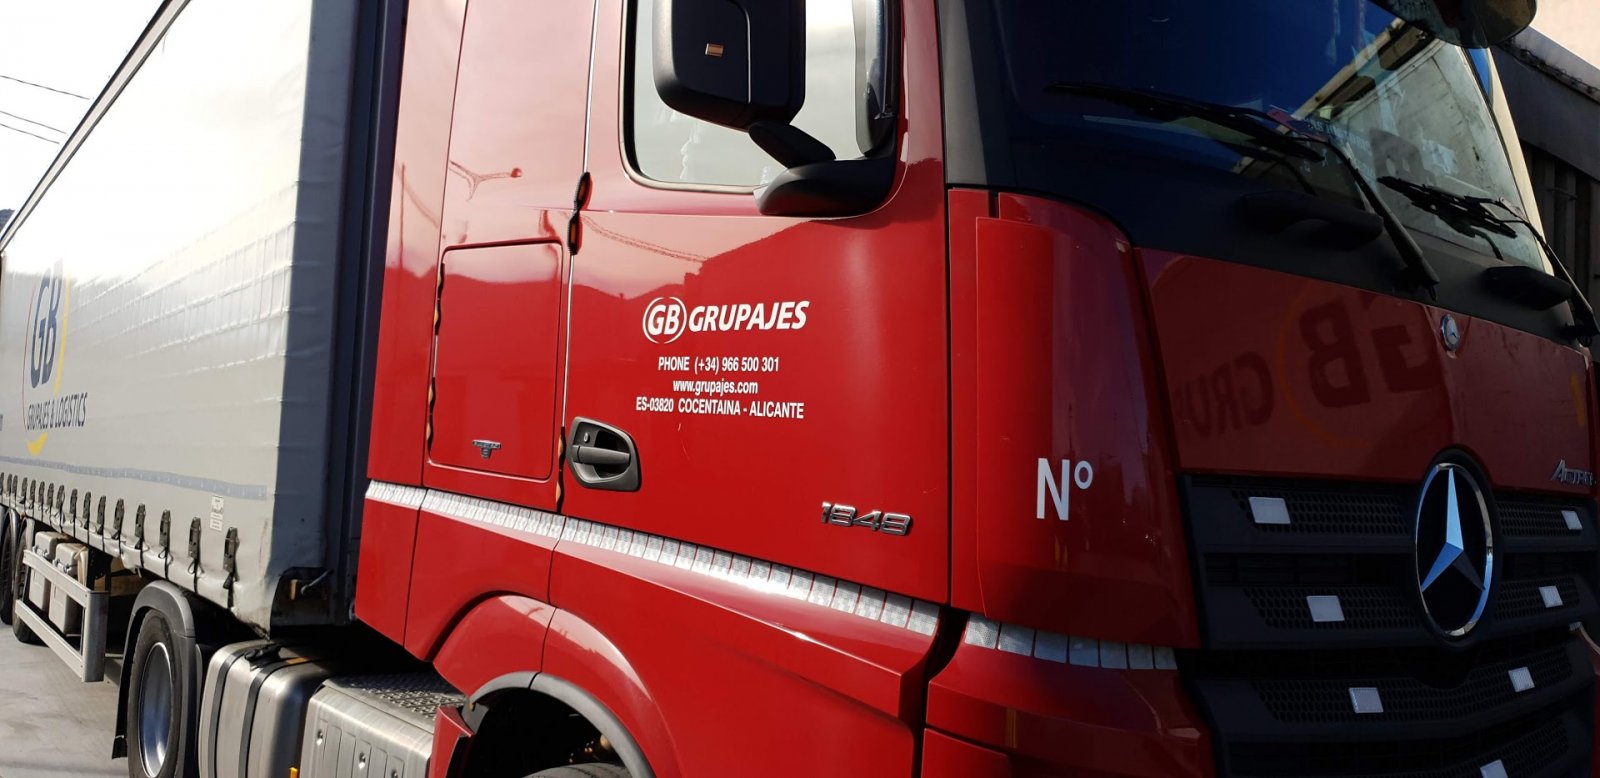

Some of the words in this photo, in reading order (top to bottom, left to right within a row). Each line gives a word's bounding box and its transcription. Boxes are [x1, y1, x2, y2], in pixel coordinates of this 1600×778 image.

[30, 257, 64, 389] GB
[648, 303, 681, 336] GB
[688, 300, 811, 333] GRUPAJES
[658, 356, 690, 371] PHONE
[694, 356, 720, 376] (+34)
[721, 356, 739, 372] 966
[741, 356, 760, 372] 500
[761, 356, 780, 373] 301
[672, 378, 759, 397] www.grupajes.com
[55, 392, 88, 428] LOGISTICS
[635, 396, 674, 412] ES-03820
[678, 398, 741, 416] COCENTAINA
[749, 400, 805, 419] ALICANTE
[821, 501, 912, 536] 1848
